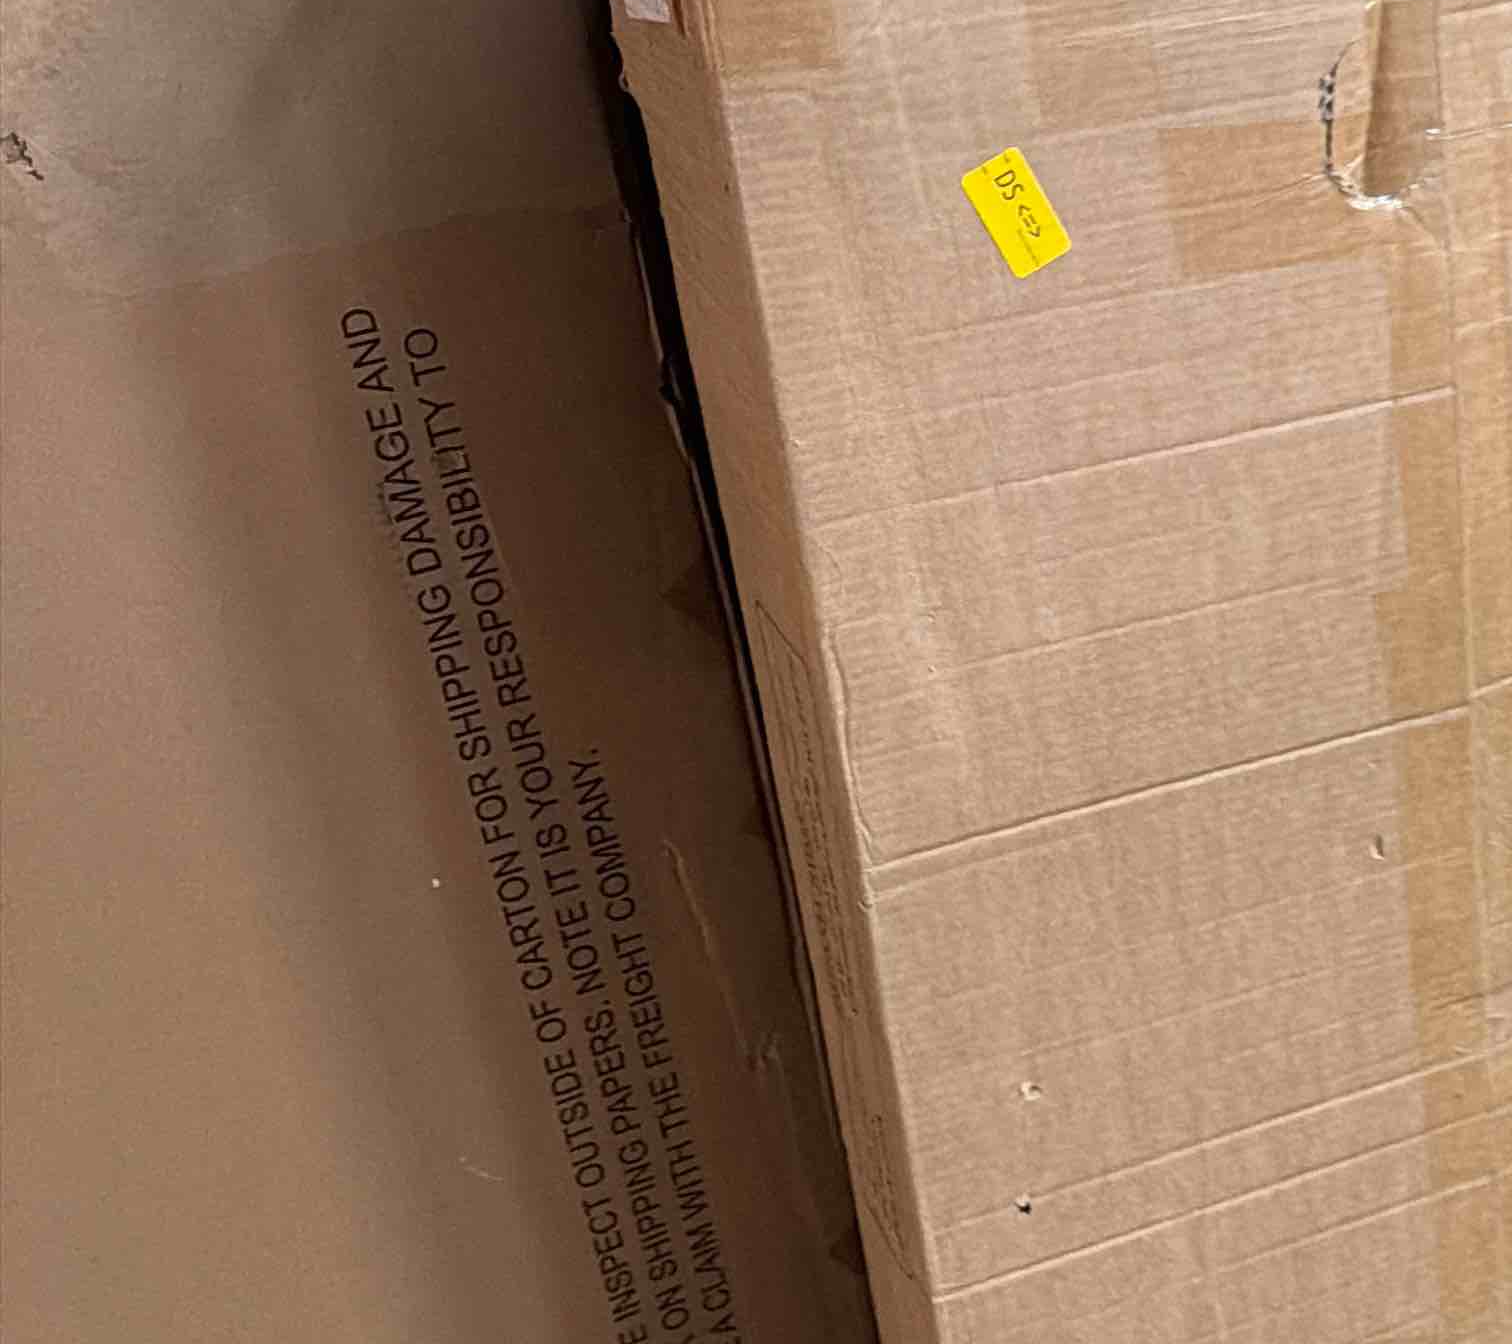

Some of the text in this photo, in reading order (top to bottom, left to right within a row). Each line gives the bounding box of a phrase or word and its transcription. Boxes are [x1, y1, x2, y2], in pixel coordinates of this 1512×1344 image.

[994, 169, 1025, 201] DS
[341, 308, 394, 392] AND
[403, 327, 447, 387] TO
[366, 403, 442, 576] DAMAGE
[418, 396, 532, 708] RESPONSIBILITY
[418, 584, 492, 762] SHIPPING
[467, 767, 515, 845] FOR
[506, 712, 559, 820] YOUR
[535, 823, 571, 859] IS
[567, 748, 636, 923] COMPANY.
[488, 850, 553, 992] CARTON
[545, 867, 581, 897] IT
[555, 900, 605, 996] NOTE
[529, 1001, 567, 1043] OF
[612, 932, 672, 1069] FREIGHT
[544, 1049, 605, 1188] OUTSIDE
[649, 1071, 689, 1140] THE
[617, 1138, 678, 1281] SHIPPING
[665, 1138, 710, 1221] WITH
[582, 1197, 642, 1323] INSPECT
[685, 1221, 731, 1313] CLAIM
[655, 1285, 690, 1331] ON
[708, 1311, 737, 1335] A
